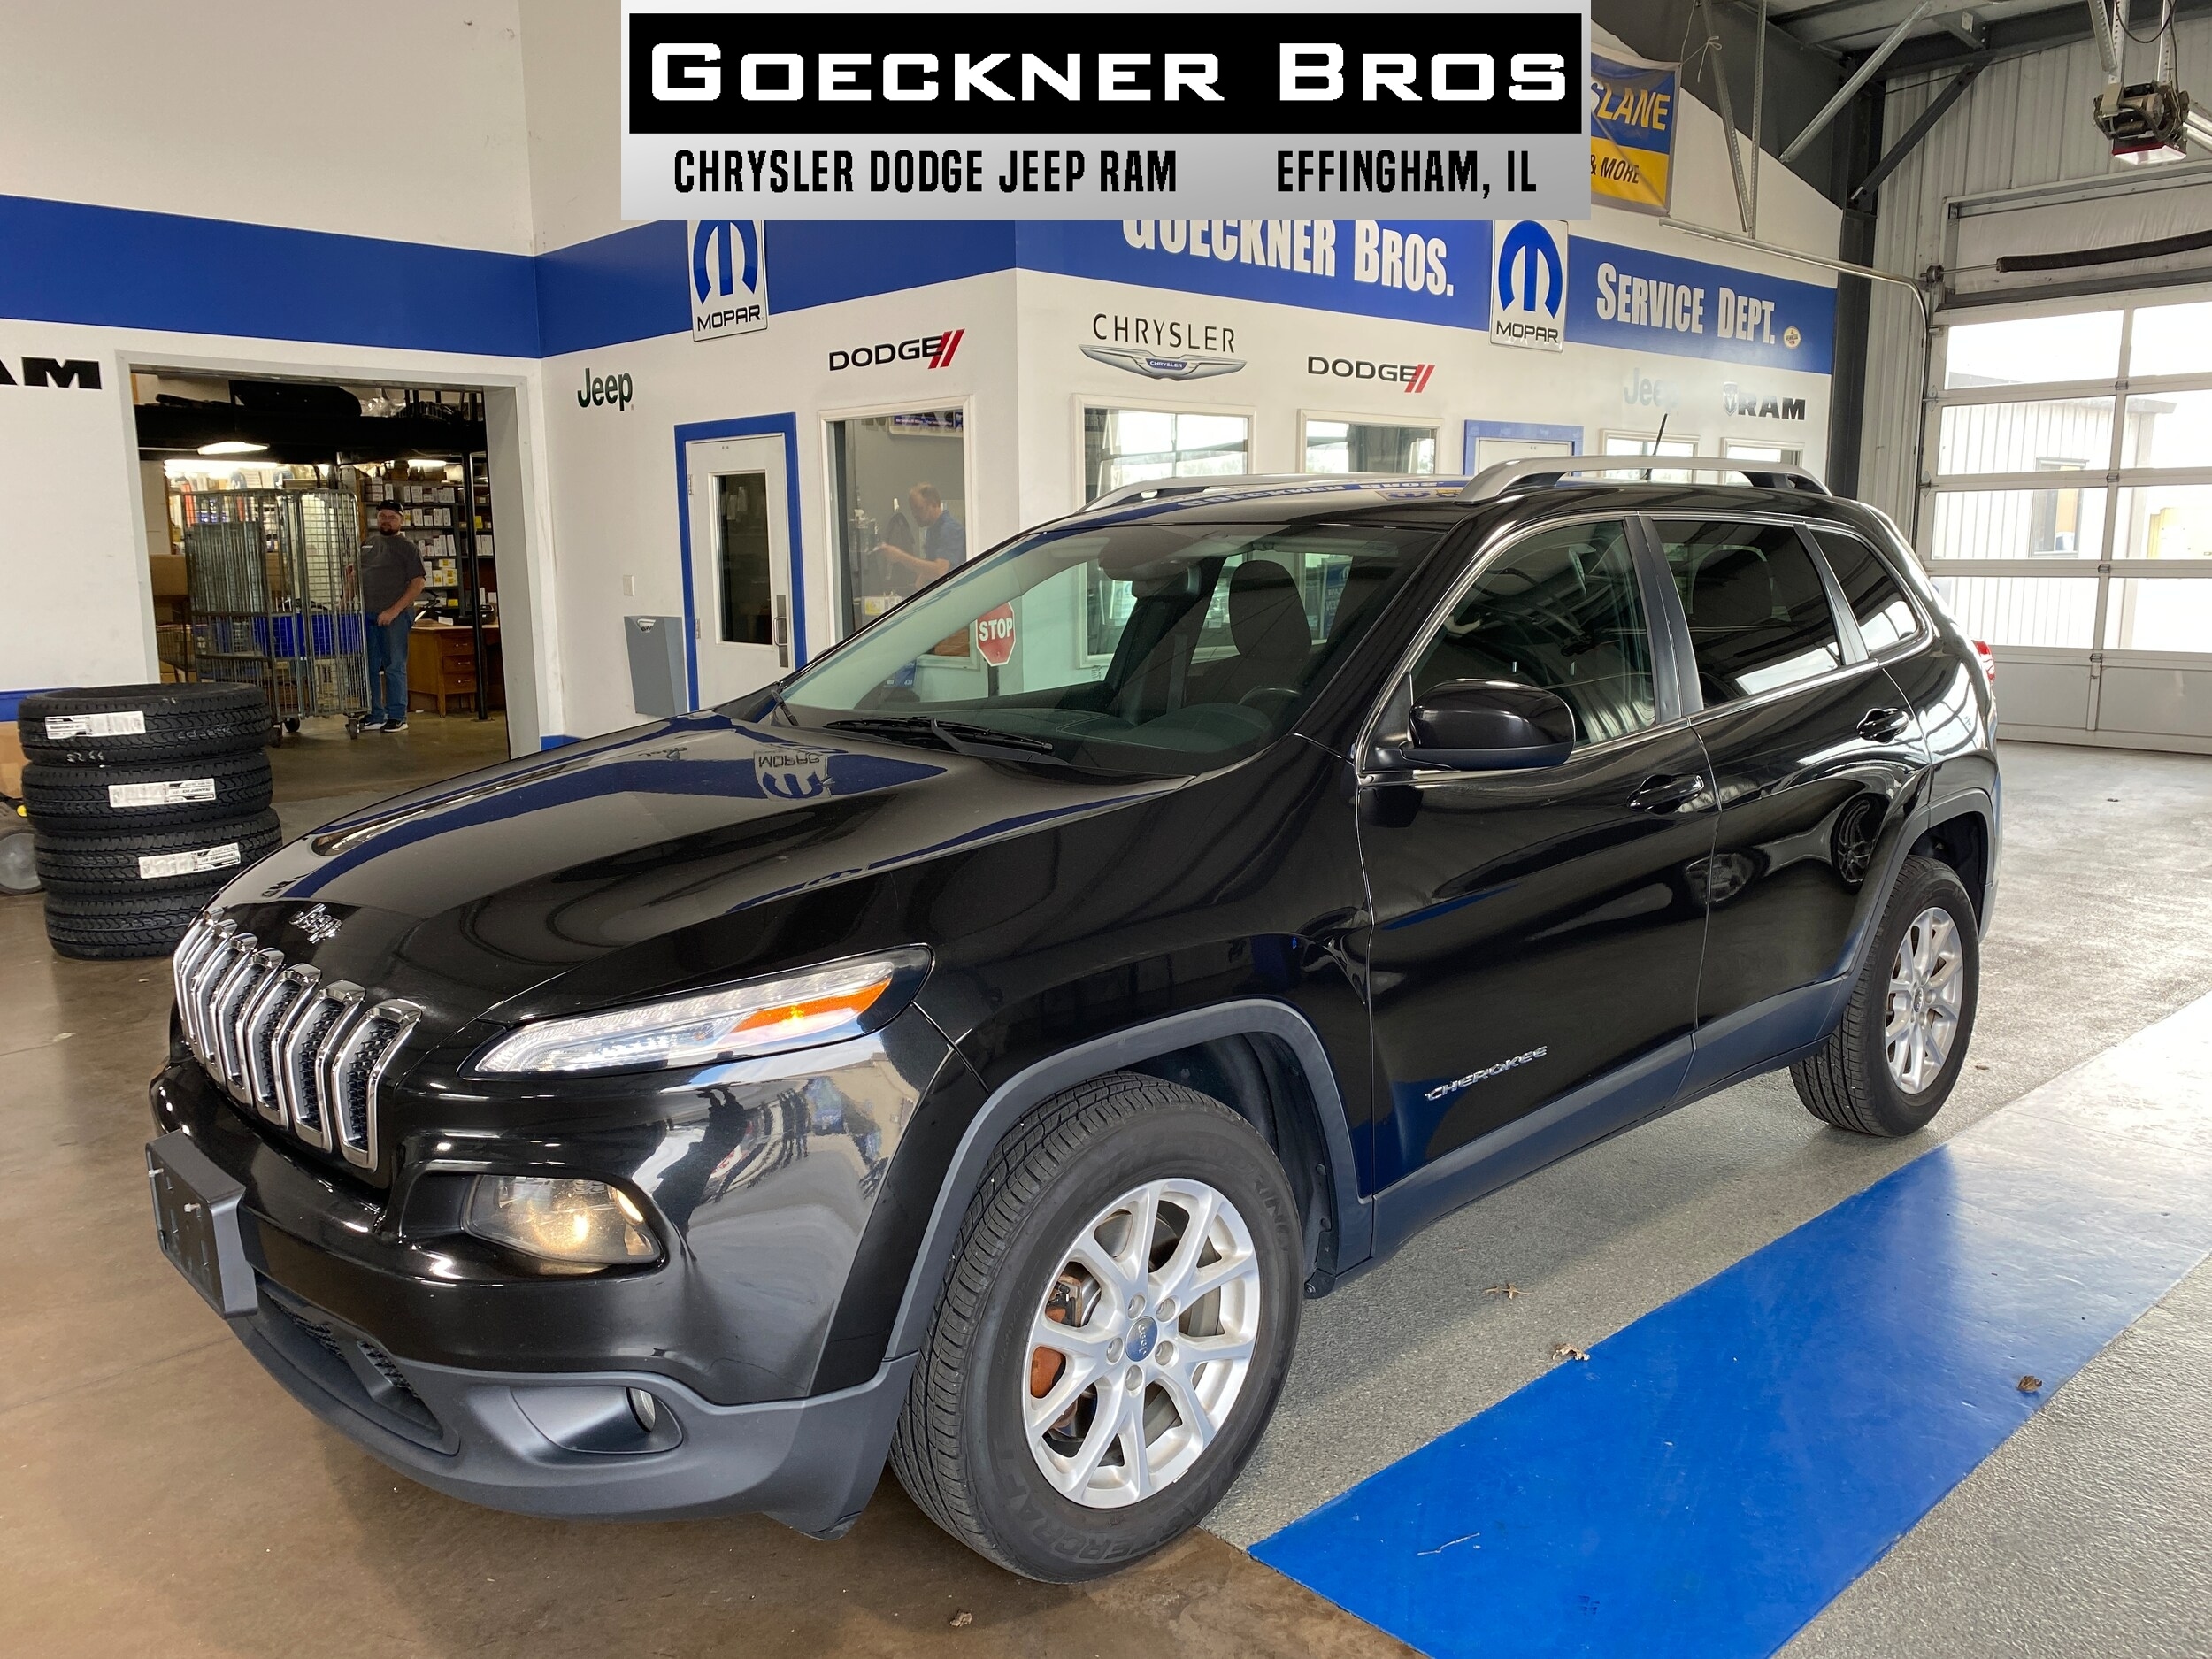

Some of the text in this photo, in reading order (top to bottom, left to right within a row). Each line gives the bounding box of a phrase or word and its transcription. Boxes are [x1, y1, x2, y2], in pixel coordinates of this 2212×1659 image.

[1600, 157, 1640, 184] MORE
[1354, 220, 1454, 296] BROS.
[697, 304, 761, 332] MOPAR
[1596, 262, 1705, 334] SERVICE
[1717, 287, 1776, 345] DEPT.
[1093, 313, 1235, 353] CHRYSLER
[1496, 320, 1559, 343] MOPAR
[829, 334, 944, 371] DODGE
[1149, 359, 1183, 369] CHRYSLER
[1308, 356, 1418, 383] DODGE
[577, 367, 634, 412] Jeep
[1738, 392, 1807, 421] RAM
[979, 617, 1013, 641] STOP
[1424, 1045, 1548, 1102] CHEROKEE
